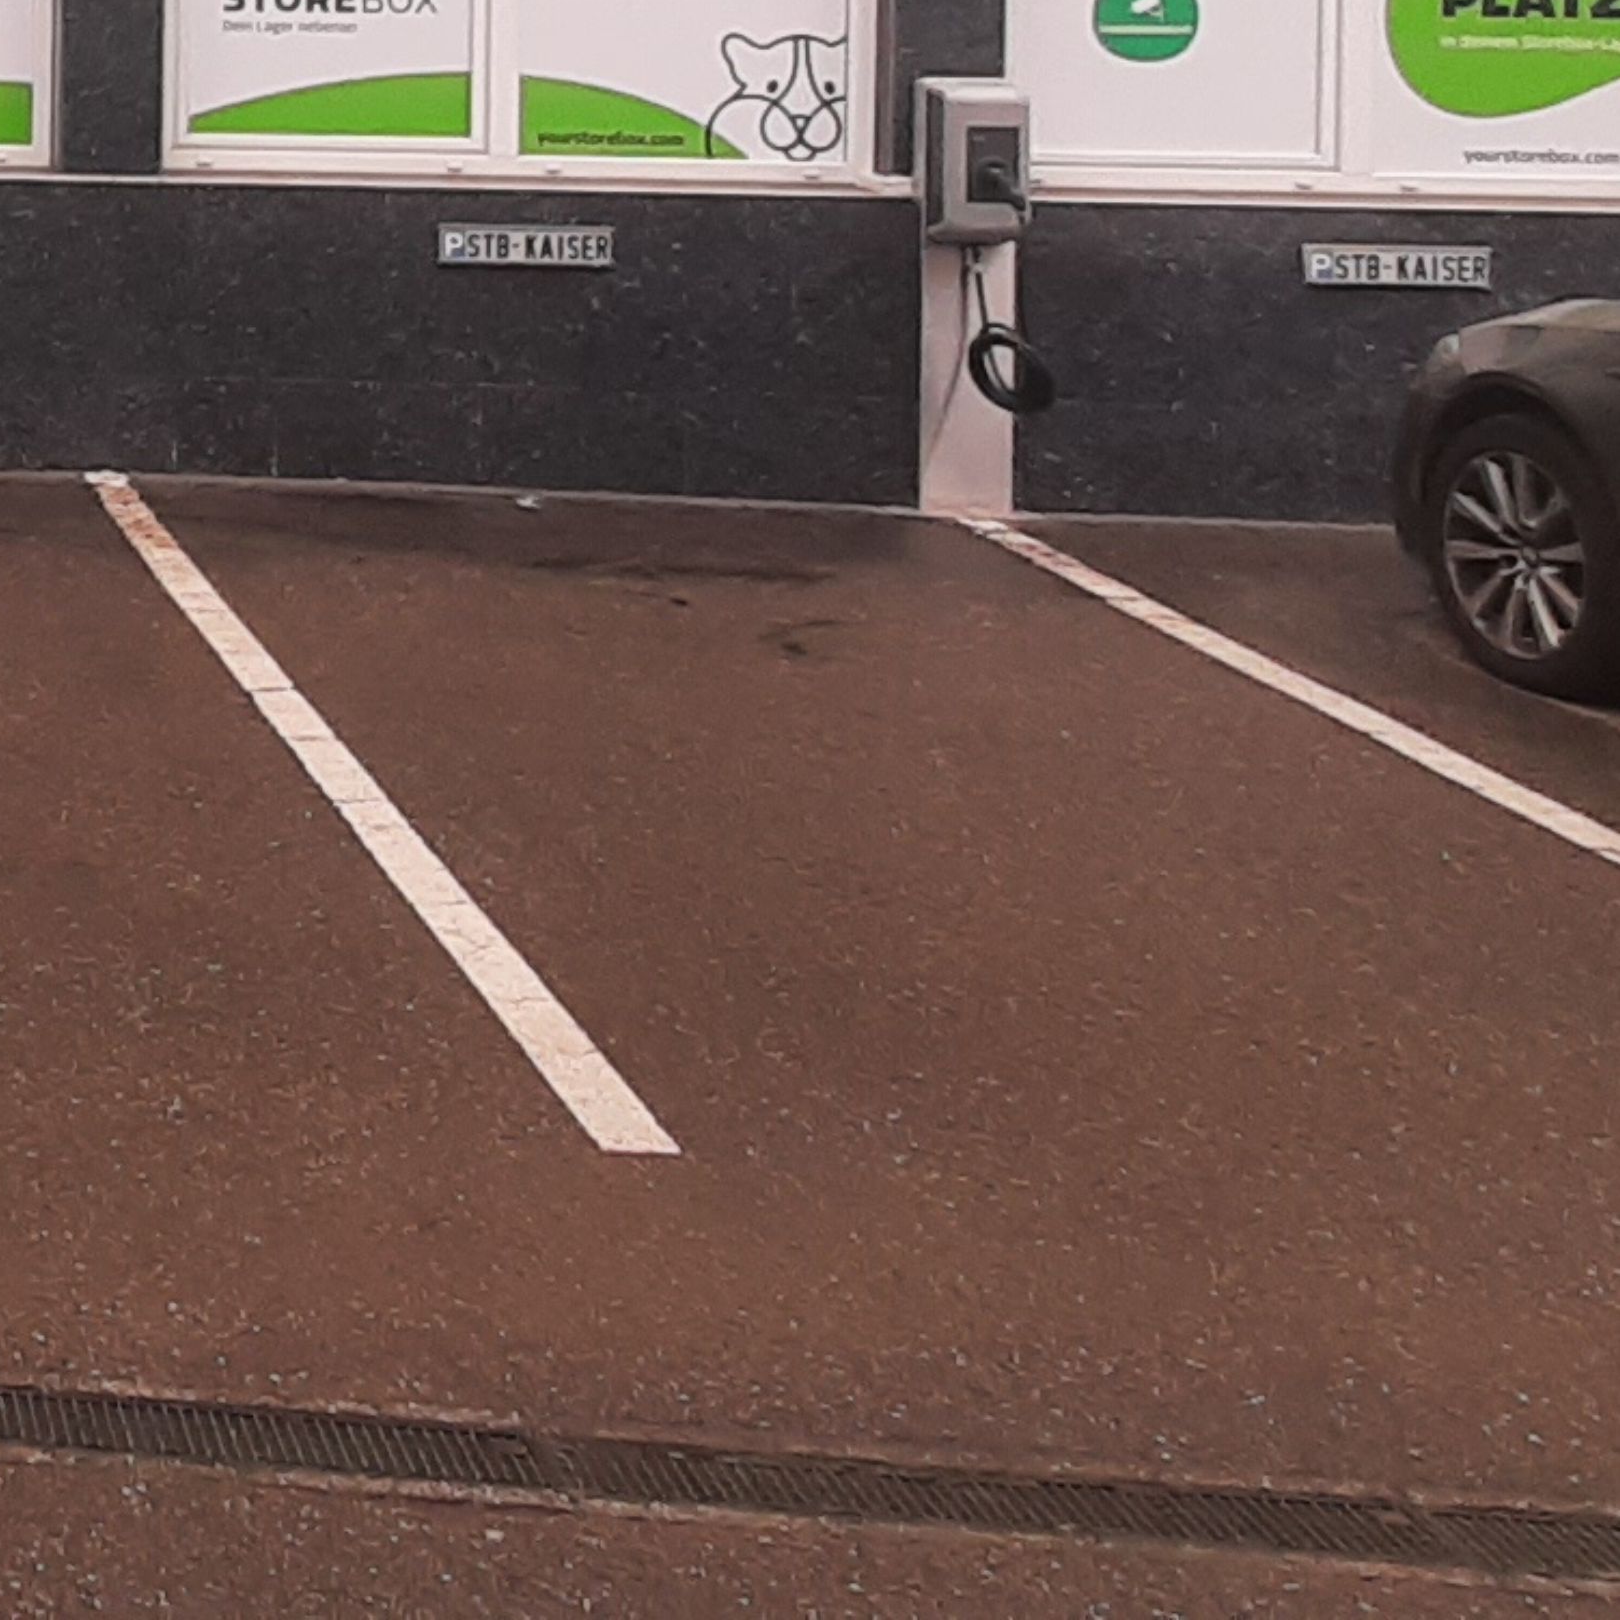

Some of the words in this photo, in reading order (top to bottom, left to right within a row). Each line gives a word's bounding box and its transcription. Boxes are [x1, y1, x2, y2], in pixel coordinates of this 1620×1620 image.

[537, 131, 685, 147] yourstorebox.com
[1463, 148, 1619, 164] yourstorebox.com
[467, 232, 609, 260] STB-KAISER
[1335, 253, 1486, 282] STB-KAISER
